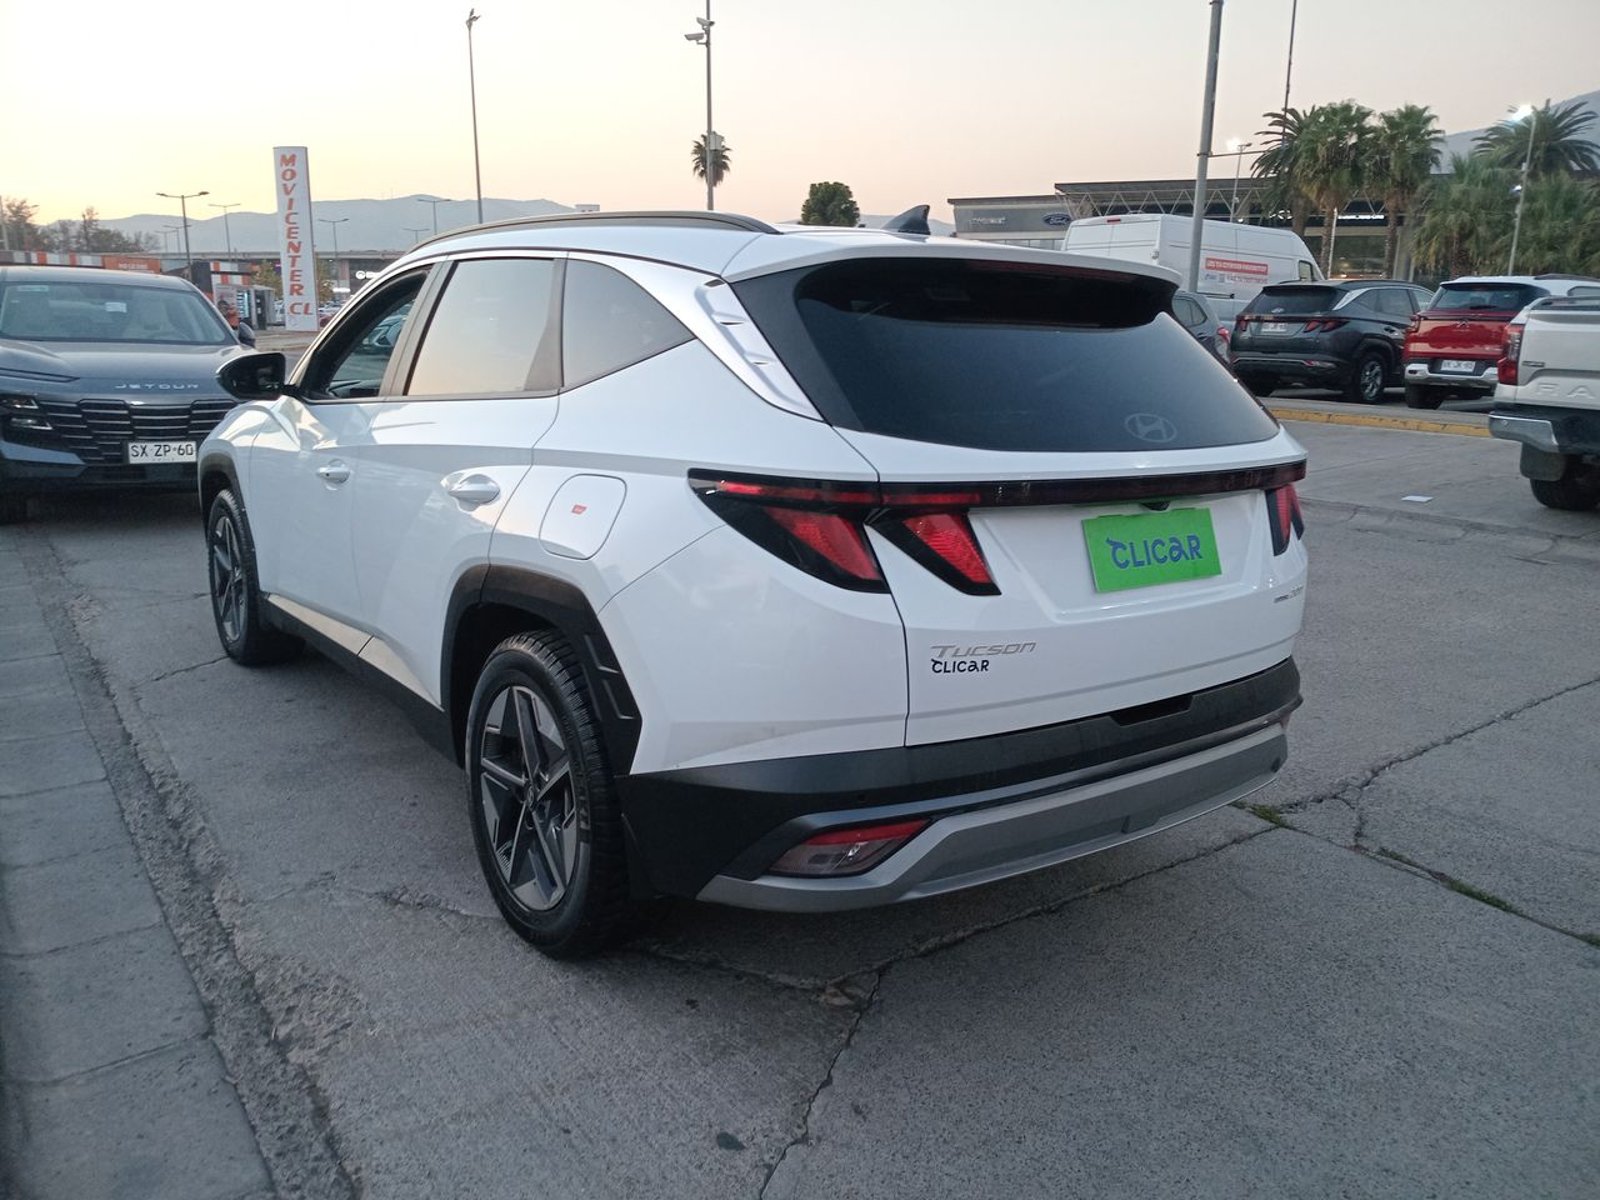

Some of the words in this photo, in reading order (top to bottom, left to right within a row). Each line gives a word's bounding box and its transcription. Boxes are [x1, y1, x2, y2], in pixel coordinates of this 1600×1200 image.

[280, 153, 304, 296] MOVICENTER
[289, 301, 313, 316] CL
[130, 444, 149, 458] SX
[154, 444, 171, 457] ZP
[177, 443, 194, 456] 60
[930, 642, 1037, 658] Tucson
